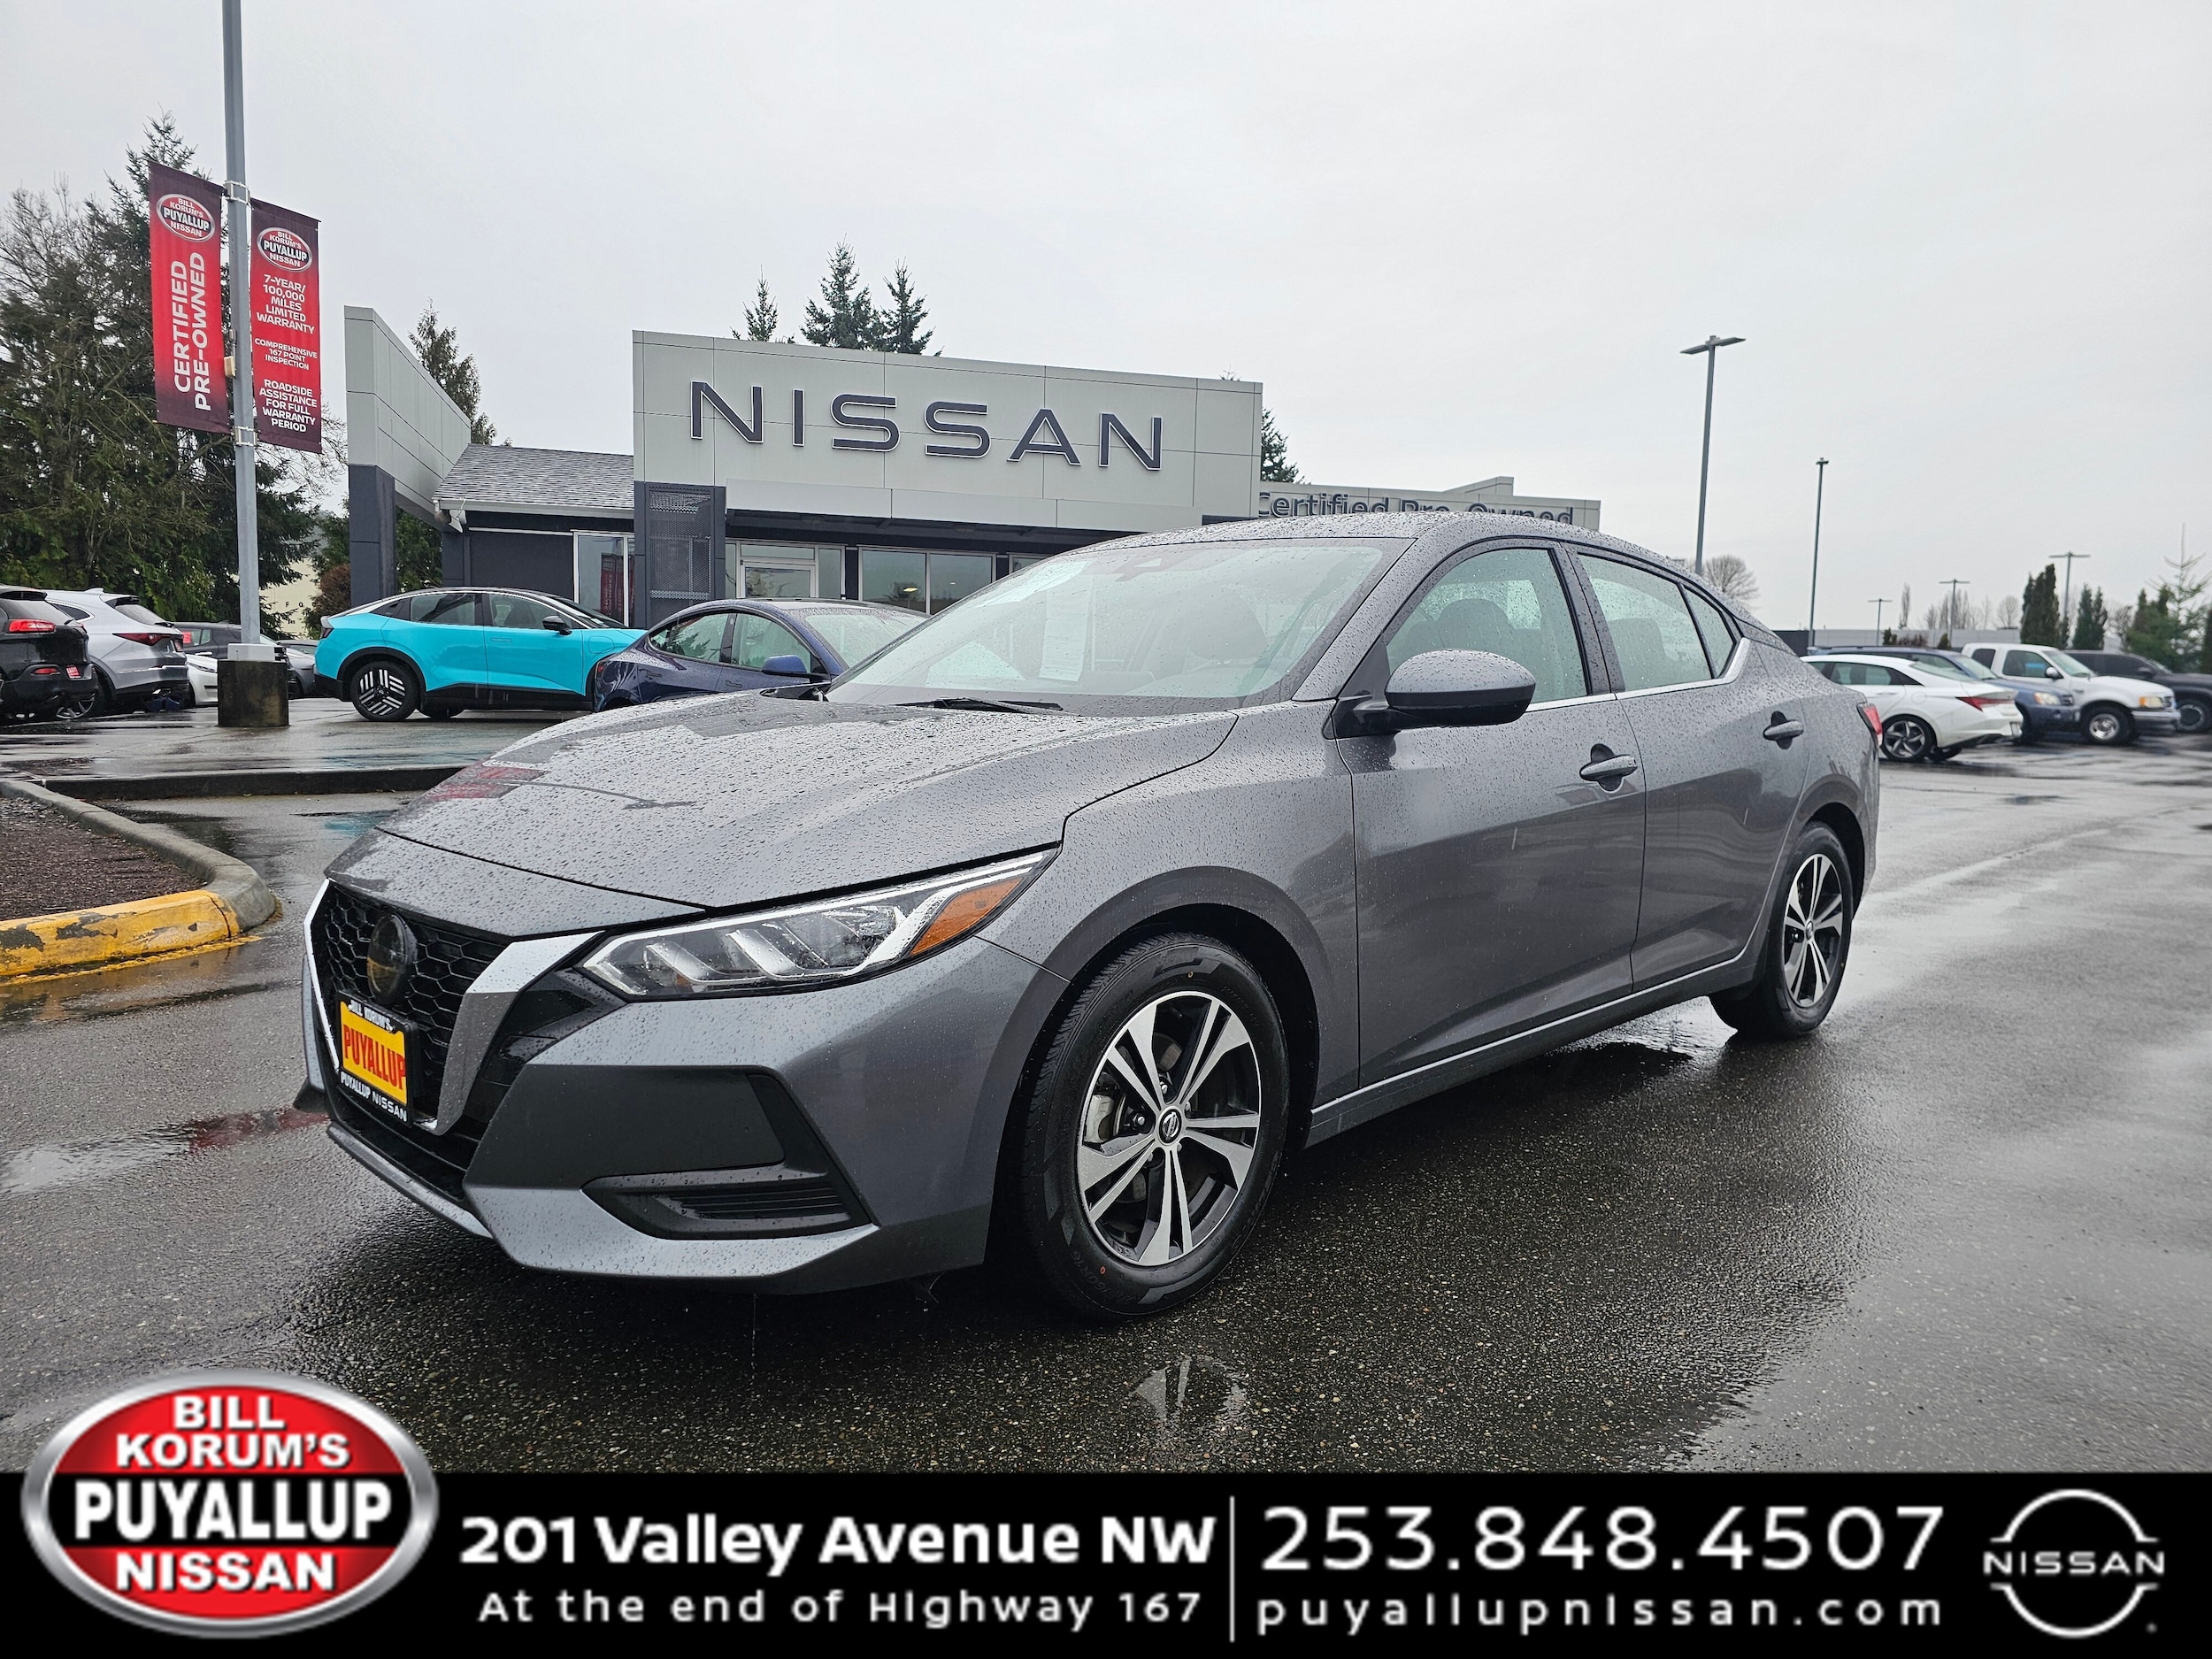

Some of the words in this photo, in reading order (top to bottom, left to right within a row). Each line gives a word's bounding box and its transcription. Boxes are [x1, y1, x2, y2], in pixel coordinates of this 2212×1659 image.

[170, 202, 204, 218] KORUM'S
[178, 198, 195, 208] BILL
[164, 207, 210, 231] PUYALLUP
[171, 221, 203, 237] NISSAN
[278, 231, 293, 241] BILL
[269, 234, 302, 249] KORUM'S
[264, 240, 308, 262] PUYALLUP
[269, 253, 301, 267] NISSAN
[264, 274, 306, 293] 7-YEAR/
[263, 284, 305, 303] 100,000
[265, 303, 306, 321] LIMITED
[271, 296, 302, 311] MILES
[171, 260, 191, 392] CERTIFIED
[190, 252, 211, 411] PRE-OWNED
[256, 312, 315, 334] WARRANTY
[255, 338, 318, 358] COMPREHENSIVE
[283, 350, 305, 363] POINT
[265, 355, 310, 370] INSPECTION
[264, 379, 313, 397] ROADSIDE
[259, 388, 318, 408] ASSISTANCE
[266, 398, 287, 410] FOR
[288, 403, 311, 416] FULL
[262, 406, 316, 426] WARRANTY
[271, 418, 307, 433] PERIOD
[690, 380, 1163, 471] NISSAN
[342, 1024, 406, 1091] PUYALLUP
[340, 1071, 372, 1099] PUYALLUP
[372, 1091, 407, 1123] NISSAN
